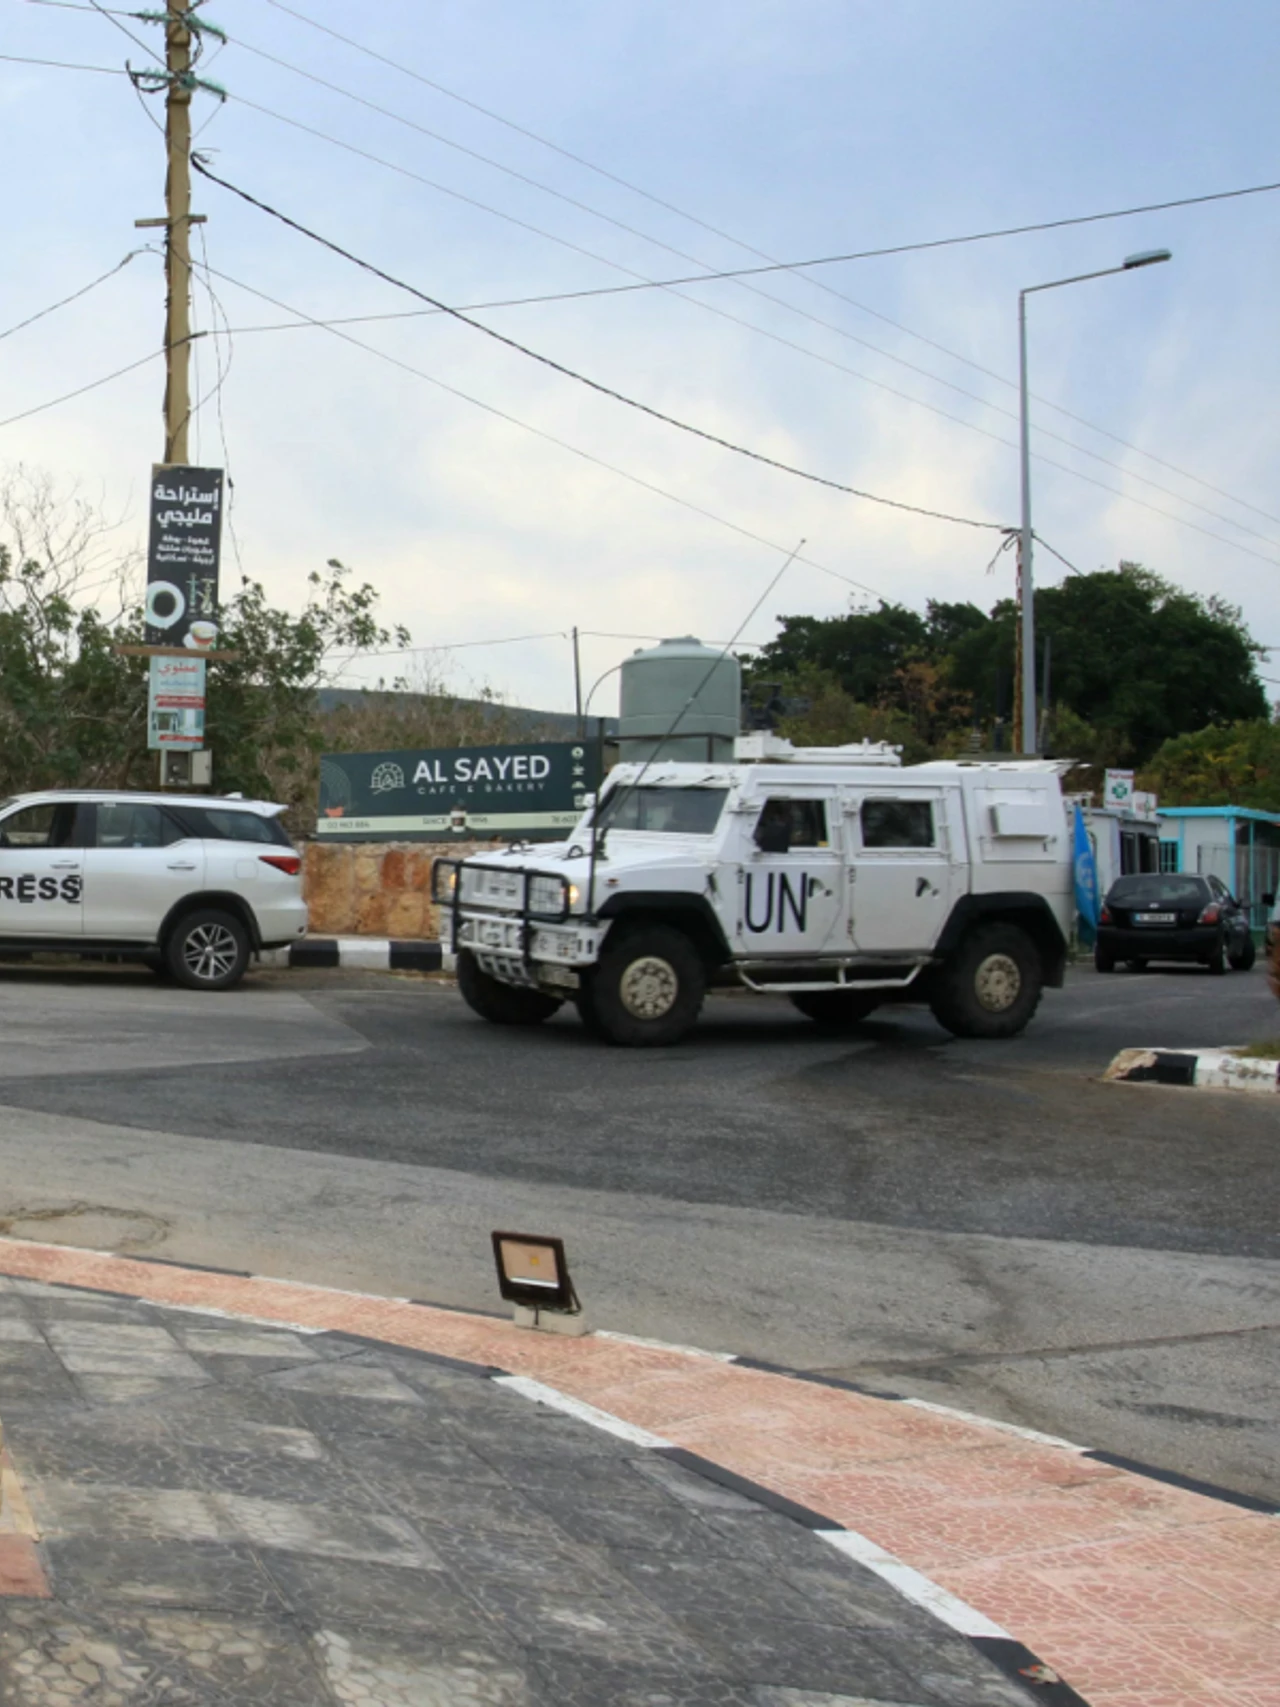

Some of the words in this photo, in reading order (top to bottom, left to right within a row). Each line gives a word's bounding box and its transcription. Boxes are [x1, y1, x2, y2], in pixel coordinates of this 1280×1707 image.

[412, 760, 448, 783] AL
[454, 755, 550, 781] SAYED
[417, 785, 456, 795] CAFE
[485, 782, 546, 792] BAKERY
[745, 872, 807, 933] UN
